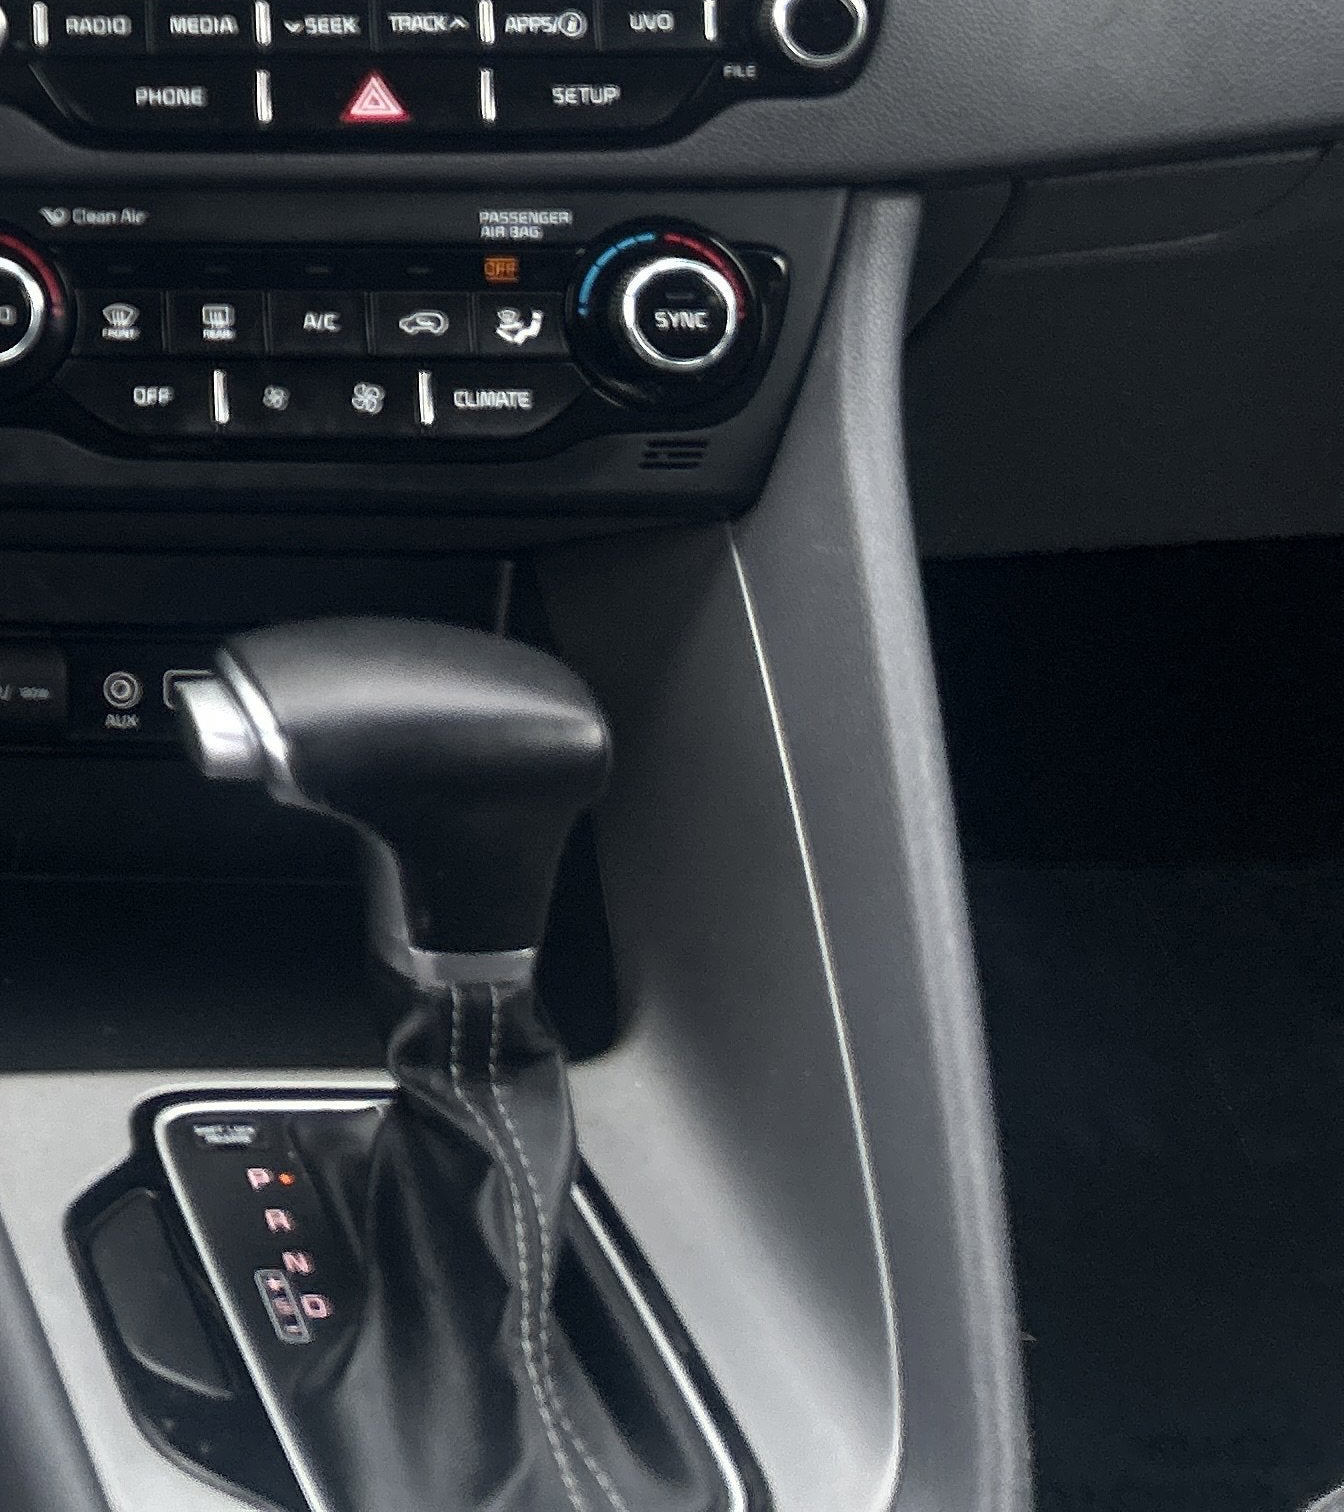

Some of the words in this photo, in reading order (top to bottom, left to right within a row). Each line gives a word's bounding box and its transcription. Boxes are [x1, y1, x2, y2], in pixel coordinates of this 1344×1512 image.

[65, 15, 132, 37] RADIO
[169, 14, 239, 36] MEDIA
[304, 14, 360, 35] SEEK
[387, 12, 449, 33] TRACK
[628, 12, 674, 31] UVO
[723, 64, 757, 80] FILE
[135, 87, 208, 107] PHONE
[552, 85, 621, 106] SETUP
[72, 208, 116, 225] Clean
[119, 207, 149, 225] Air
[478, 211, 573, 225] PASSENGER
[480, 226, 506, 238] AIR
[509, 226, 542, 239] BAG
[484, 259, 518, 279] OFF
[303, 311, 341, 332] A/C
[654, 310, 709, 331] SYNC
[101, 327, 141, 340] FRONT
[202, 327, 236, 340] REAR
[133, 386, 174, 407] OFF
[452, 389, 533, 409] CLIMATE
[104, 713, 140, 729] AUX
[246, 1167, 274, 1191] P
[264, 1208, 295, 1233] R
[281, 1251, 314, 1276] N
[300, 1293, 332, 1319] D
